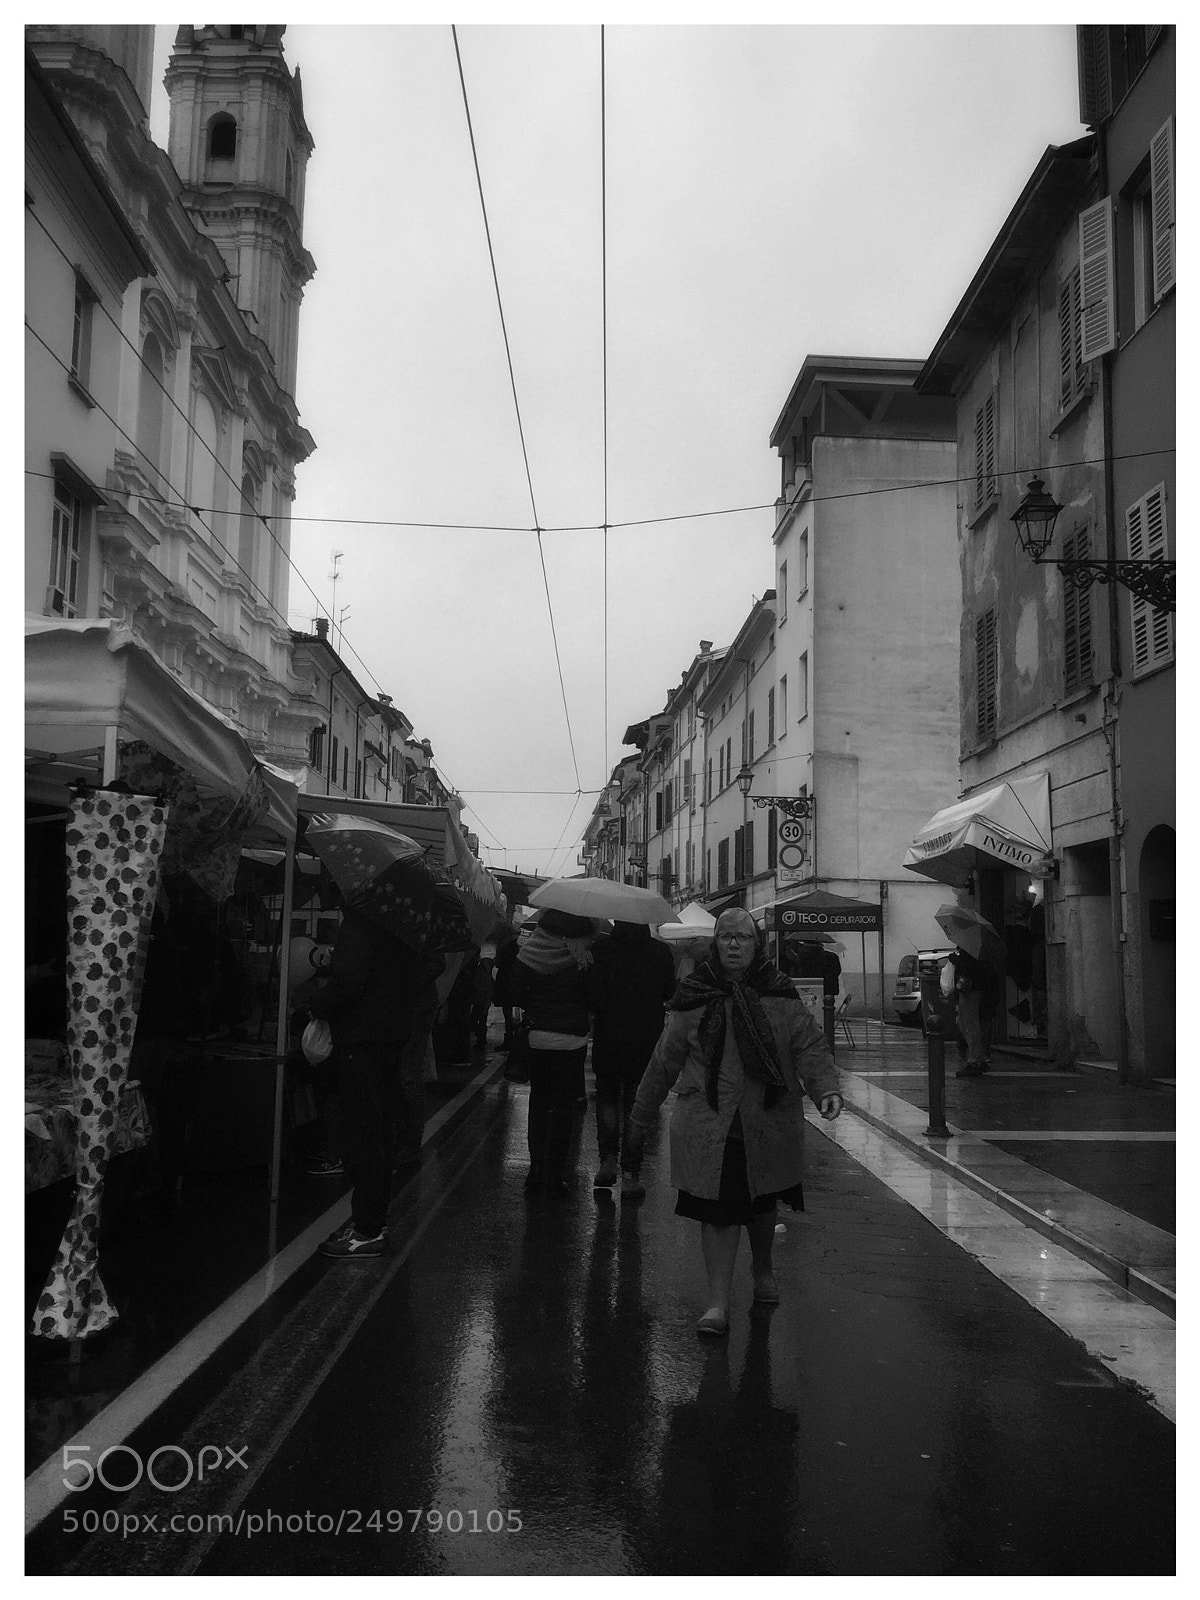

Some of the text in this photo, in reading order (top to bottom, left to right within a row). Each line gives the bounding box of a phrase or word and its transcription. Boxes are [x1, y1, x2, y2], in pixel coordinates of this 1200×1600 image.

[784, 826, 799, 838] 30
[983, 835, 1032, 865] INTIMO
[797, 912, 876, 925] TECO DEPURATORI
